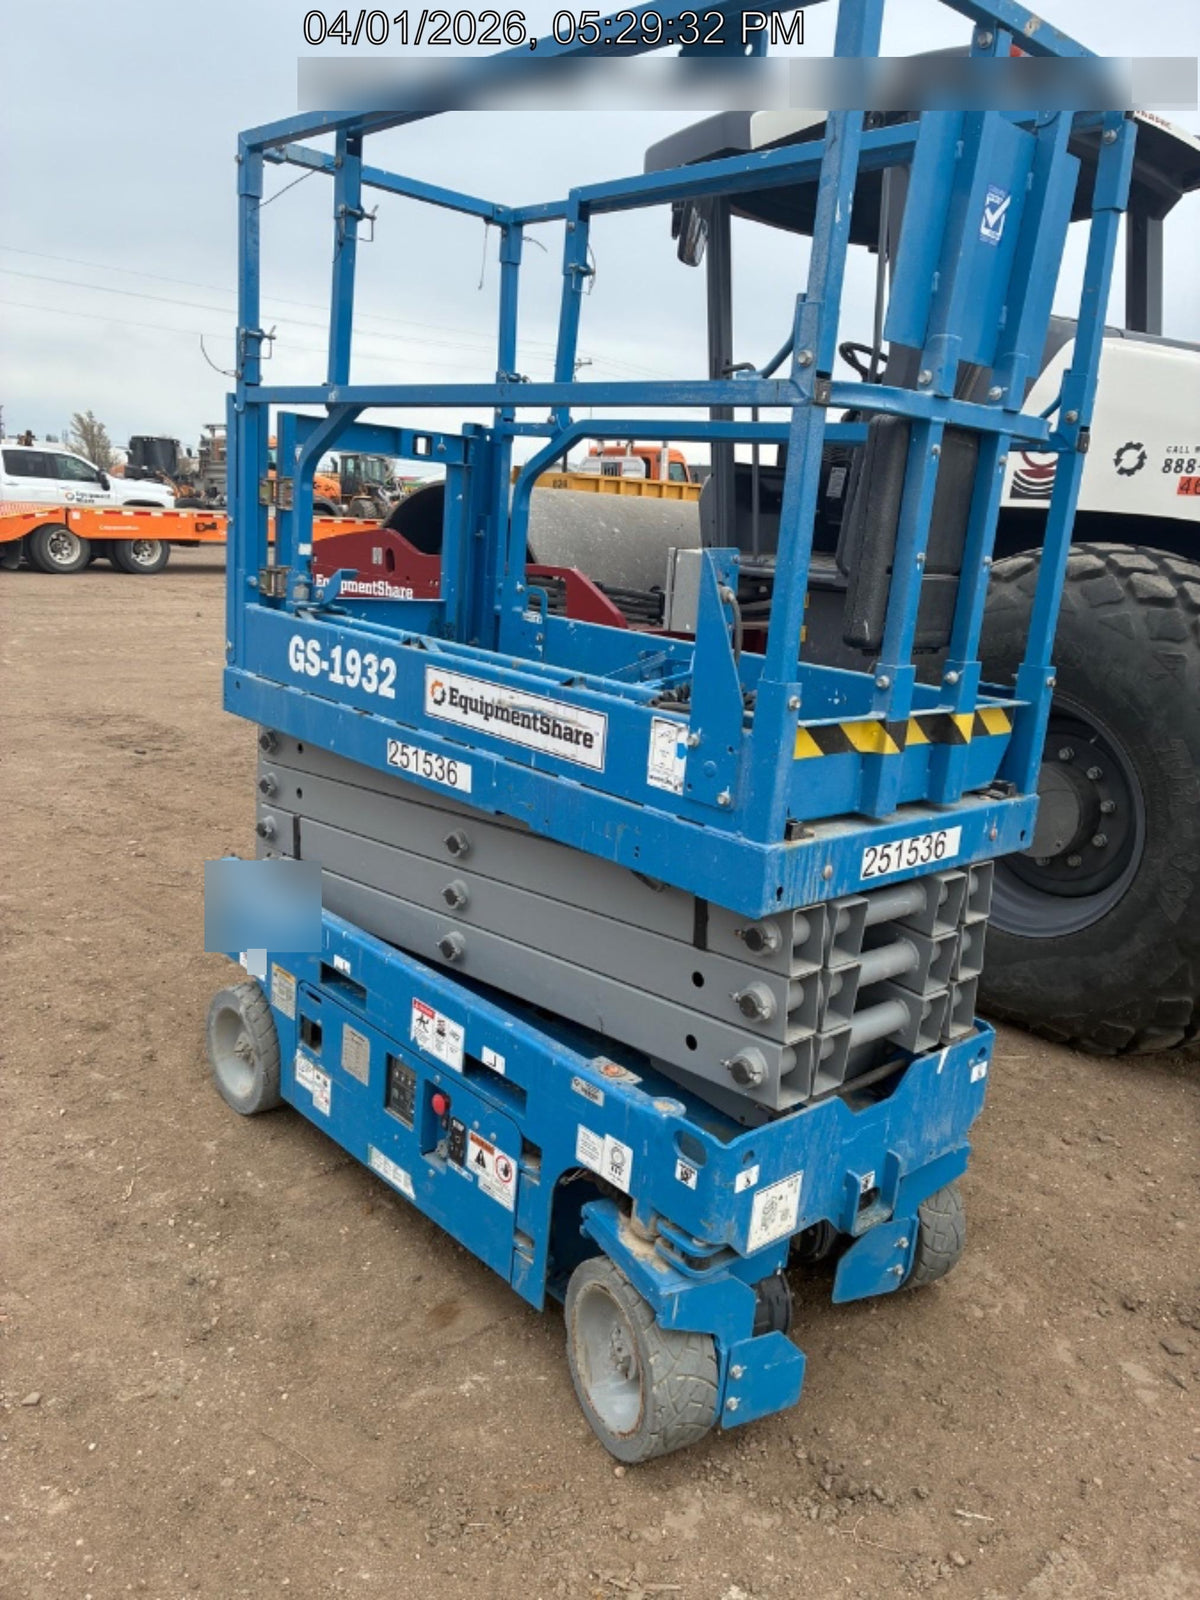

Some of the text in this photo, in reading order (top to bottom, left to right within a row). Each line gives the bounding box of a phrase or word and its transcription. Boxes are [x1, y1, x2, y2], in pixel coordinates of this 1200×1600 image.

[316, 573, 413, 599] EpmentShare
[288, 634, 397, 699] GS-1932
[449, 687, 594, 749] EquipmentShare
[389, 741, 458, 786] 251536
[862, 831, 947, 878] 251536
